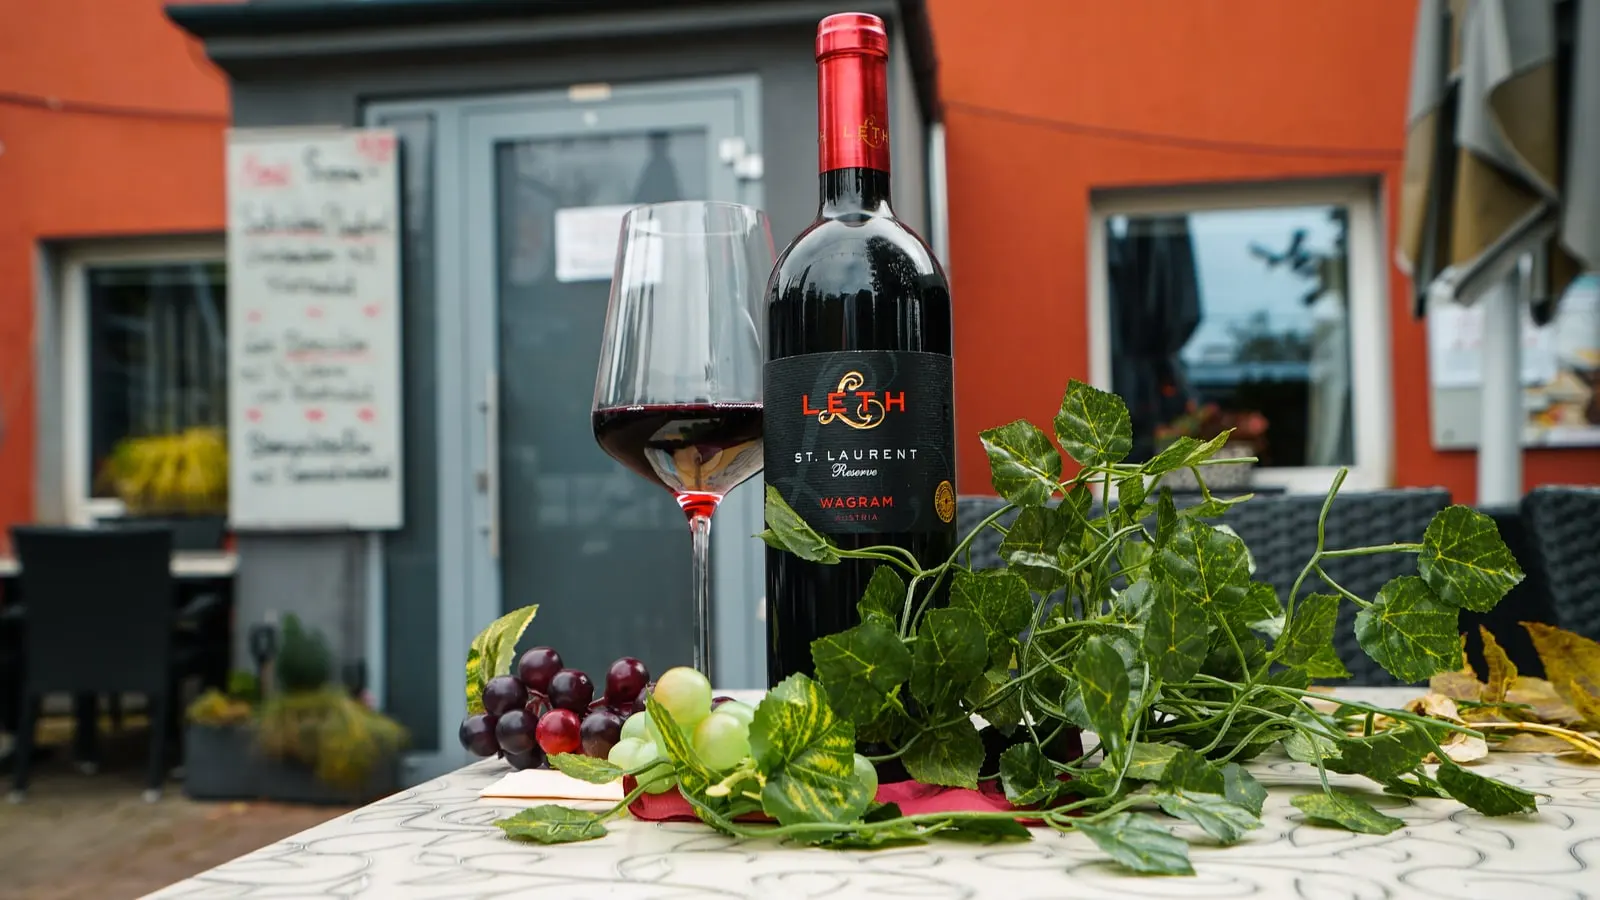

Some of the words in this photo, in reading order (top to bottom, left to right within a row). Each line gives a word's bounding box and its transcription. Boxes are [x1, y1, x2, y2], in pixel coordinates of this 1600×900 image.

[843, 125, 888, 143] LETH
[802, 391, 906, 415] LETH
[794, 451, 818, 463] ST.
[827, 449, 918, 461] LAURENT
[831, 462, 878, 478] Reserve
[820, 495, 893, 509] WAGRAM
[834, 513, 878, 522] AUSTRIA
